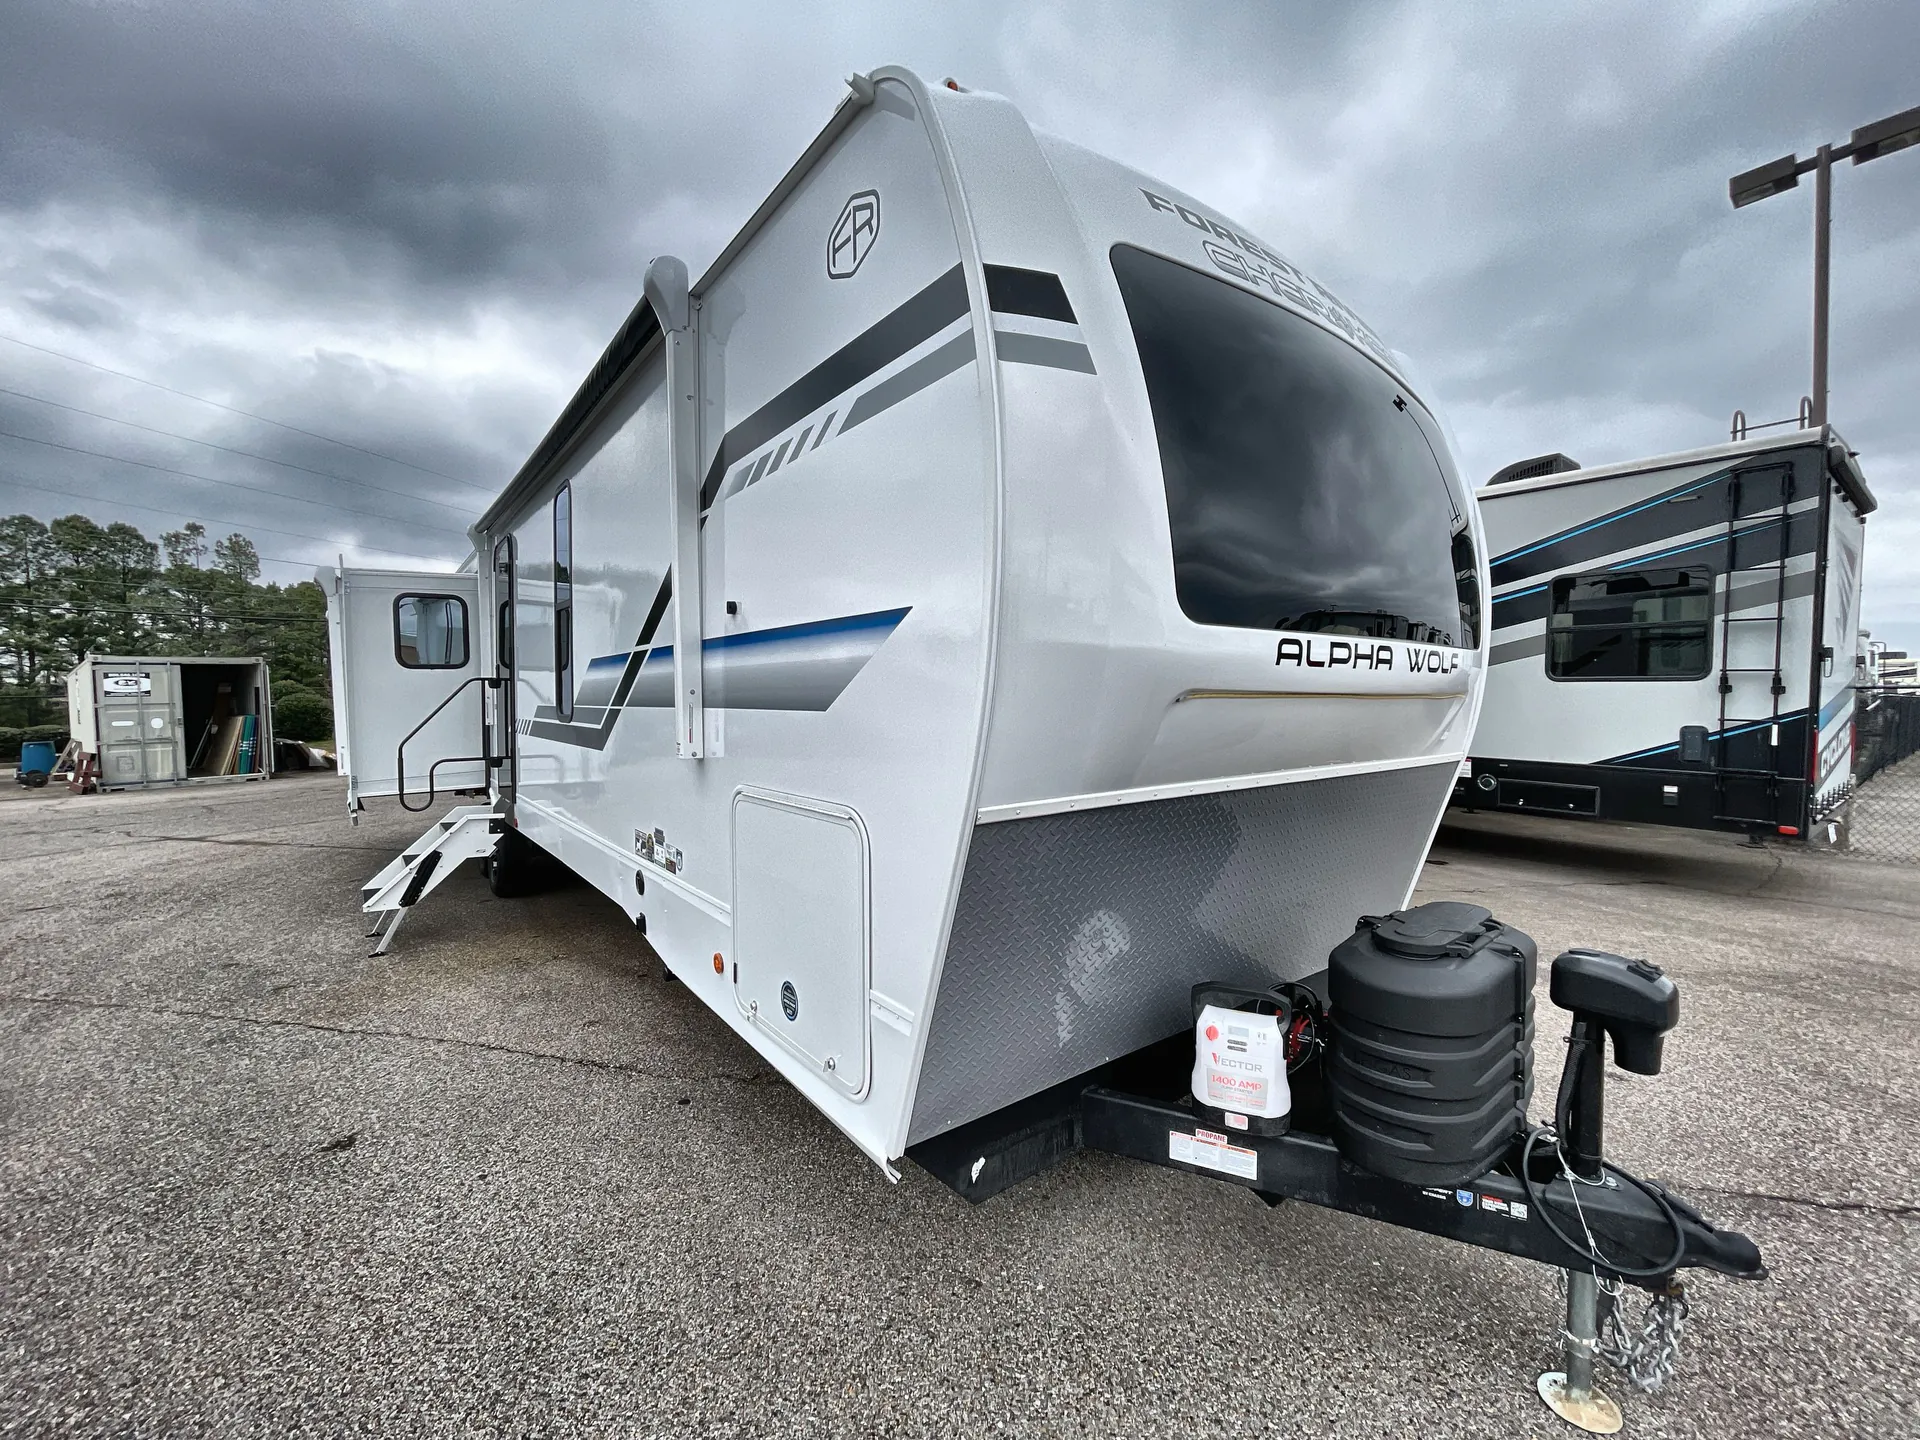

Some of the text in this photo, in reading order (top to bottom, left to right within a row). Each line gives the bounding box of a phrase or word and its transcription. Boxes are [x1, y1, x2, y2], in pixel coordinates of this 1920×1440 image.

[1138, 186, 1305, 284] FOREST
[1275, 637, 1459, 674] ALPHA WOLF
[1211, 1052, 1263, 1073] VECTOR
[1212, 1074, 1262, 1092] 1400 AMP
[1196, 1130, 1227, 1143] PROPANE
